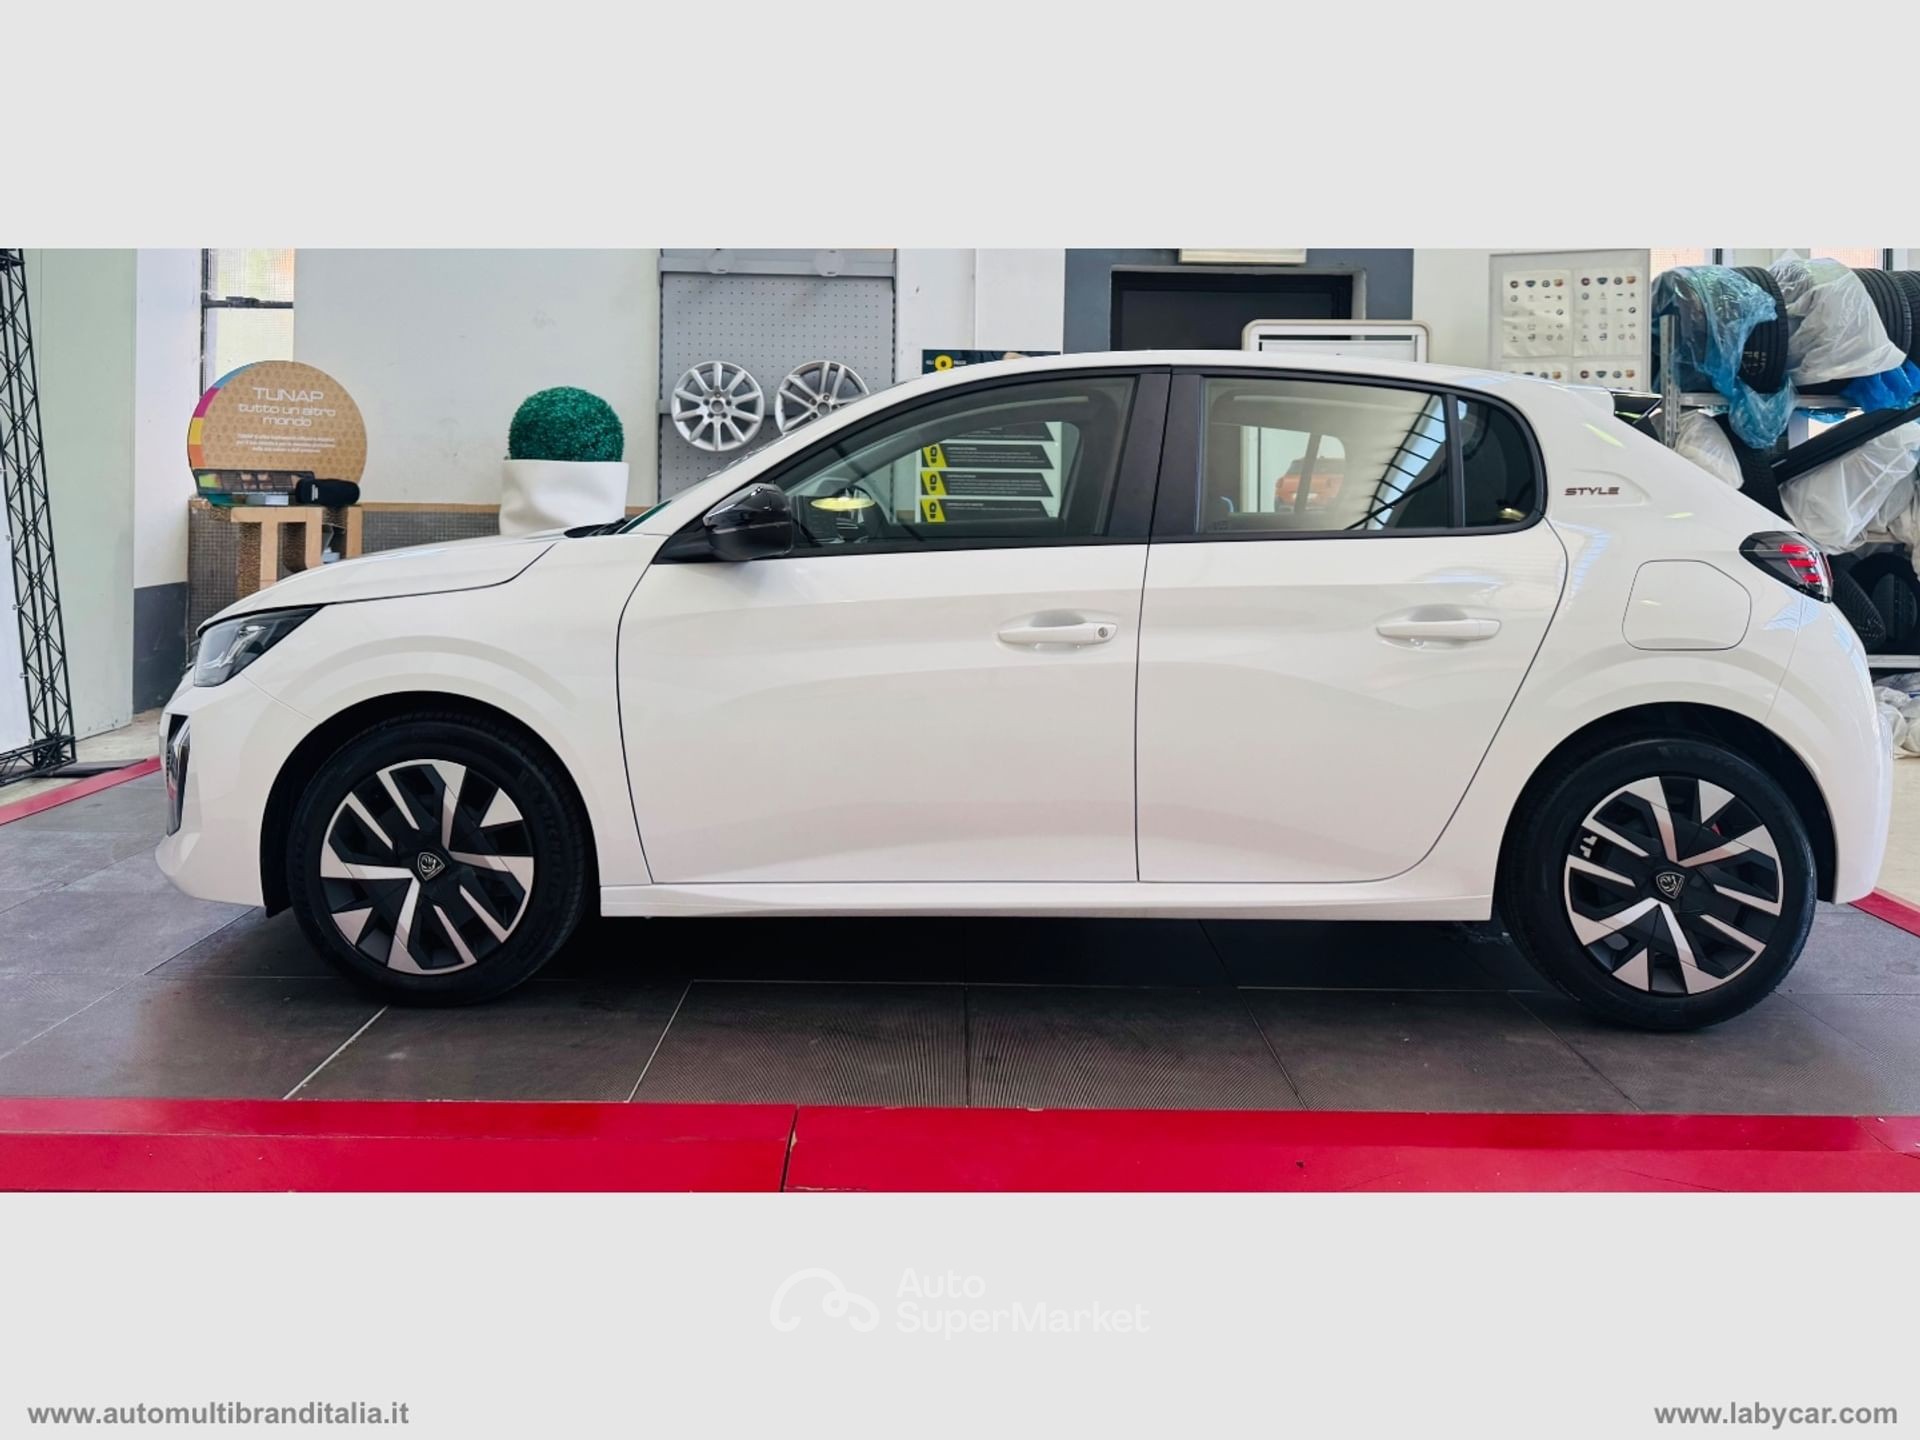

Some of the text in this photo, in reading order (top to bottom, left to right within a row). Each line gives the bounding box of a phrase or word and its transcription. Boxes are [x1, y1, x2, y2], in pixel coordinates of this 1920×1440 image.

[253, 387, 324, 402] TUNAP
[238, 403, 280, 414] tutto
[282, 406, 300, 415] un
[262, 416, 312, 427] mondo
[1564, 486, 1620, 496] STYLE
